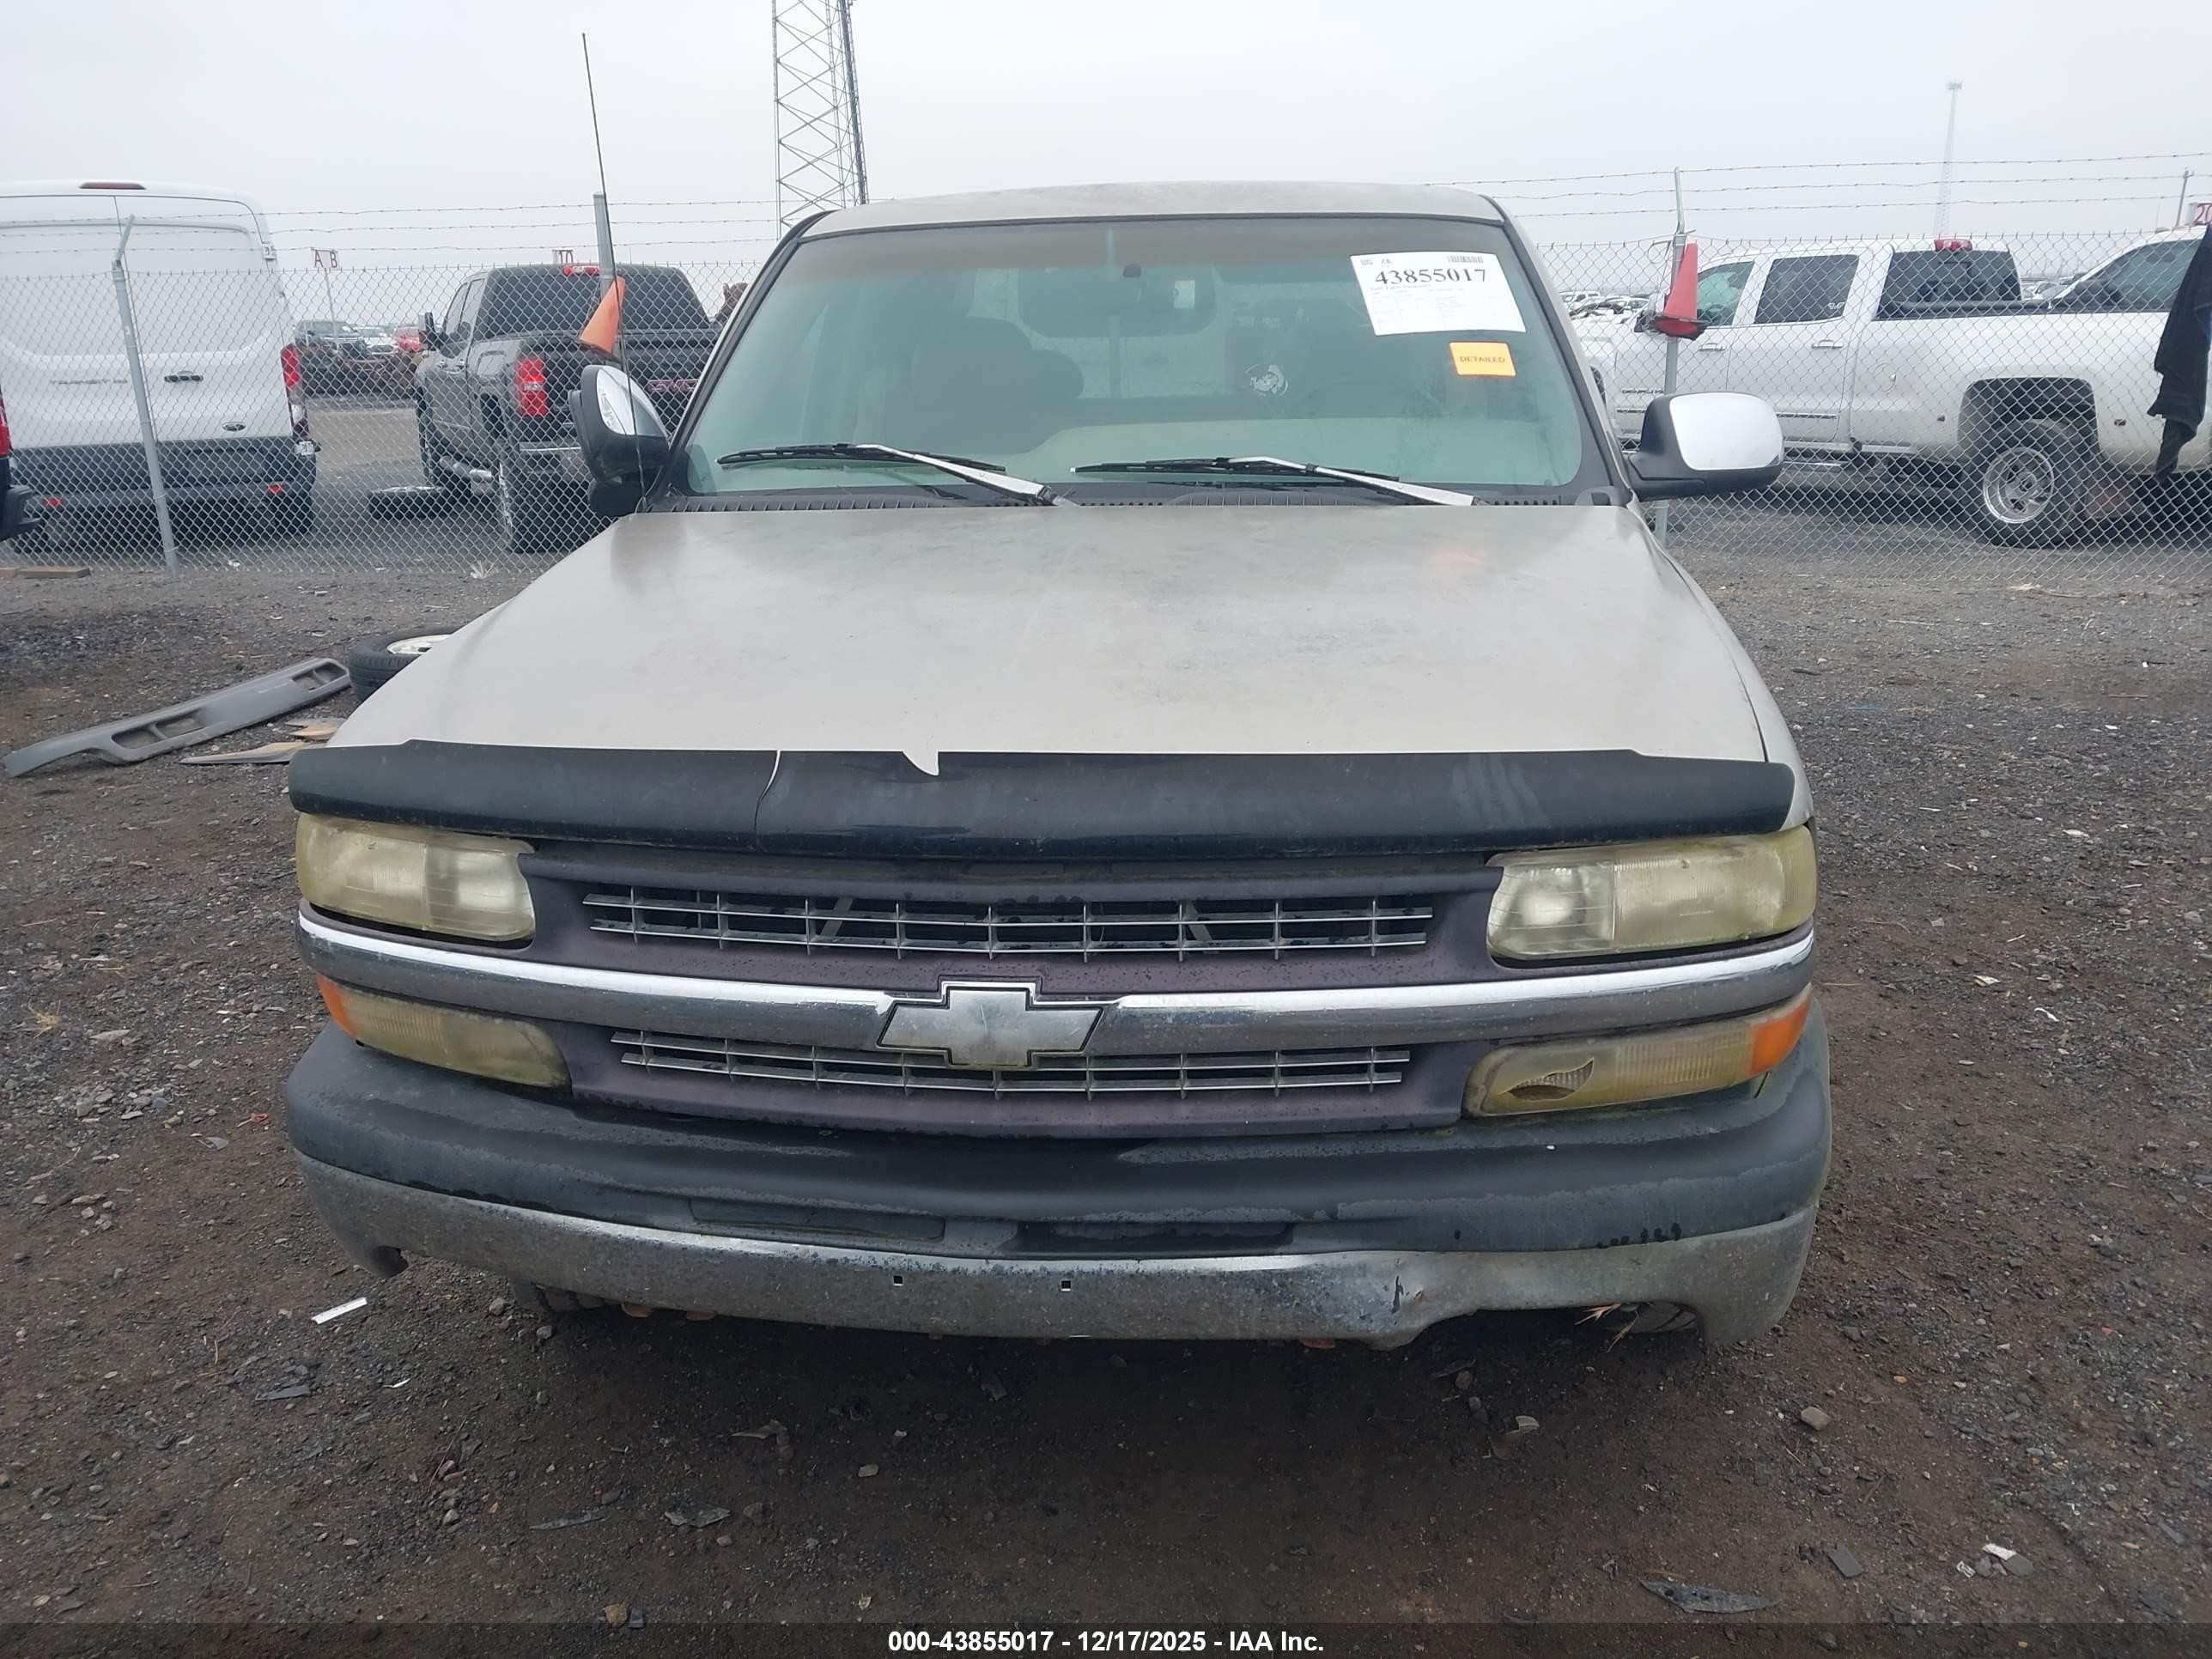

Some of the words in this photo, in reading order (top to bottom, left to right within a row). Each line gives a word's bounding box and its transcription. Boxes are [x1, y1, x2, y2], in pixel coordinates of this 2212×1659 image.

[314, 250, 324, 268] A
[330, 251, 338, 268] B
[1375, 268, 1486, 285] 43855017
